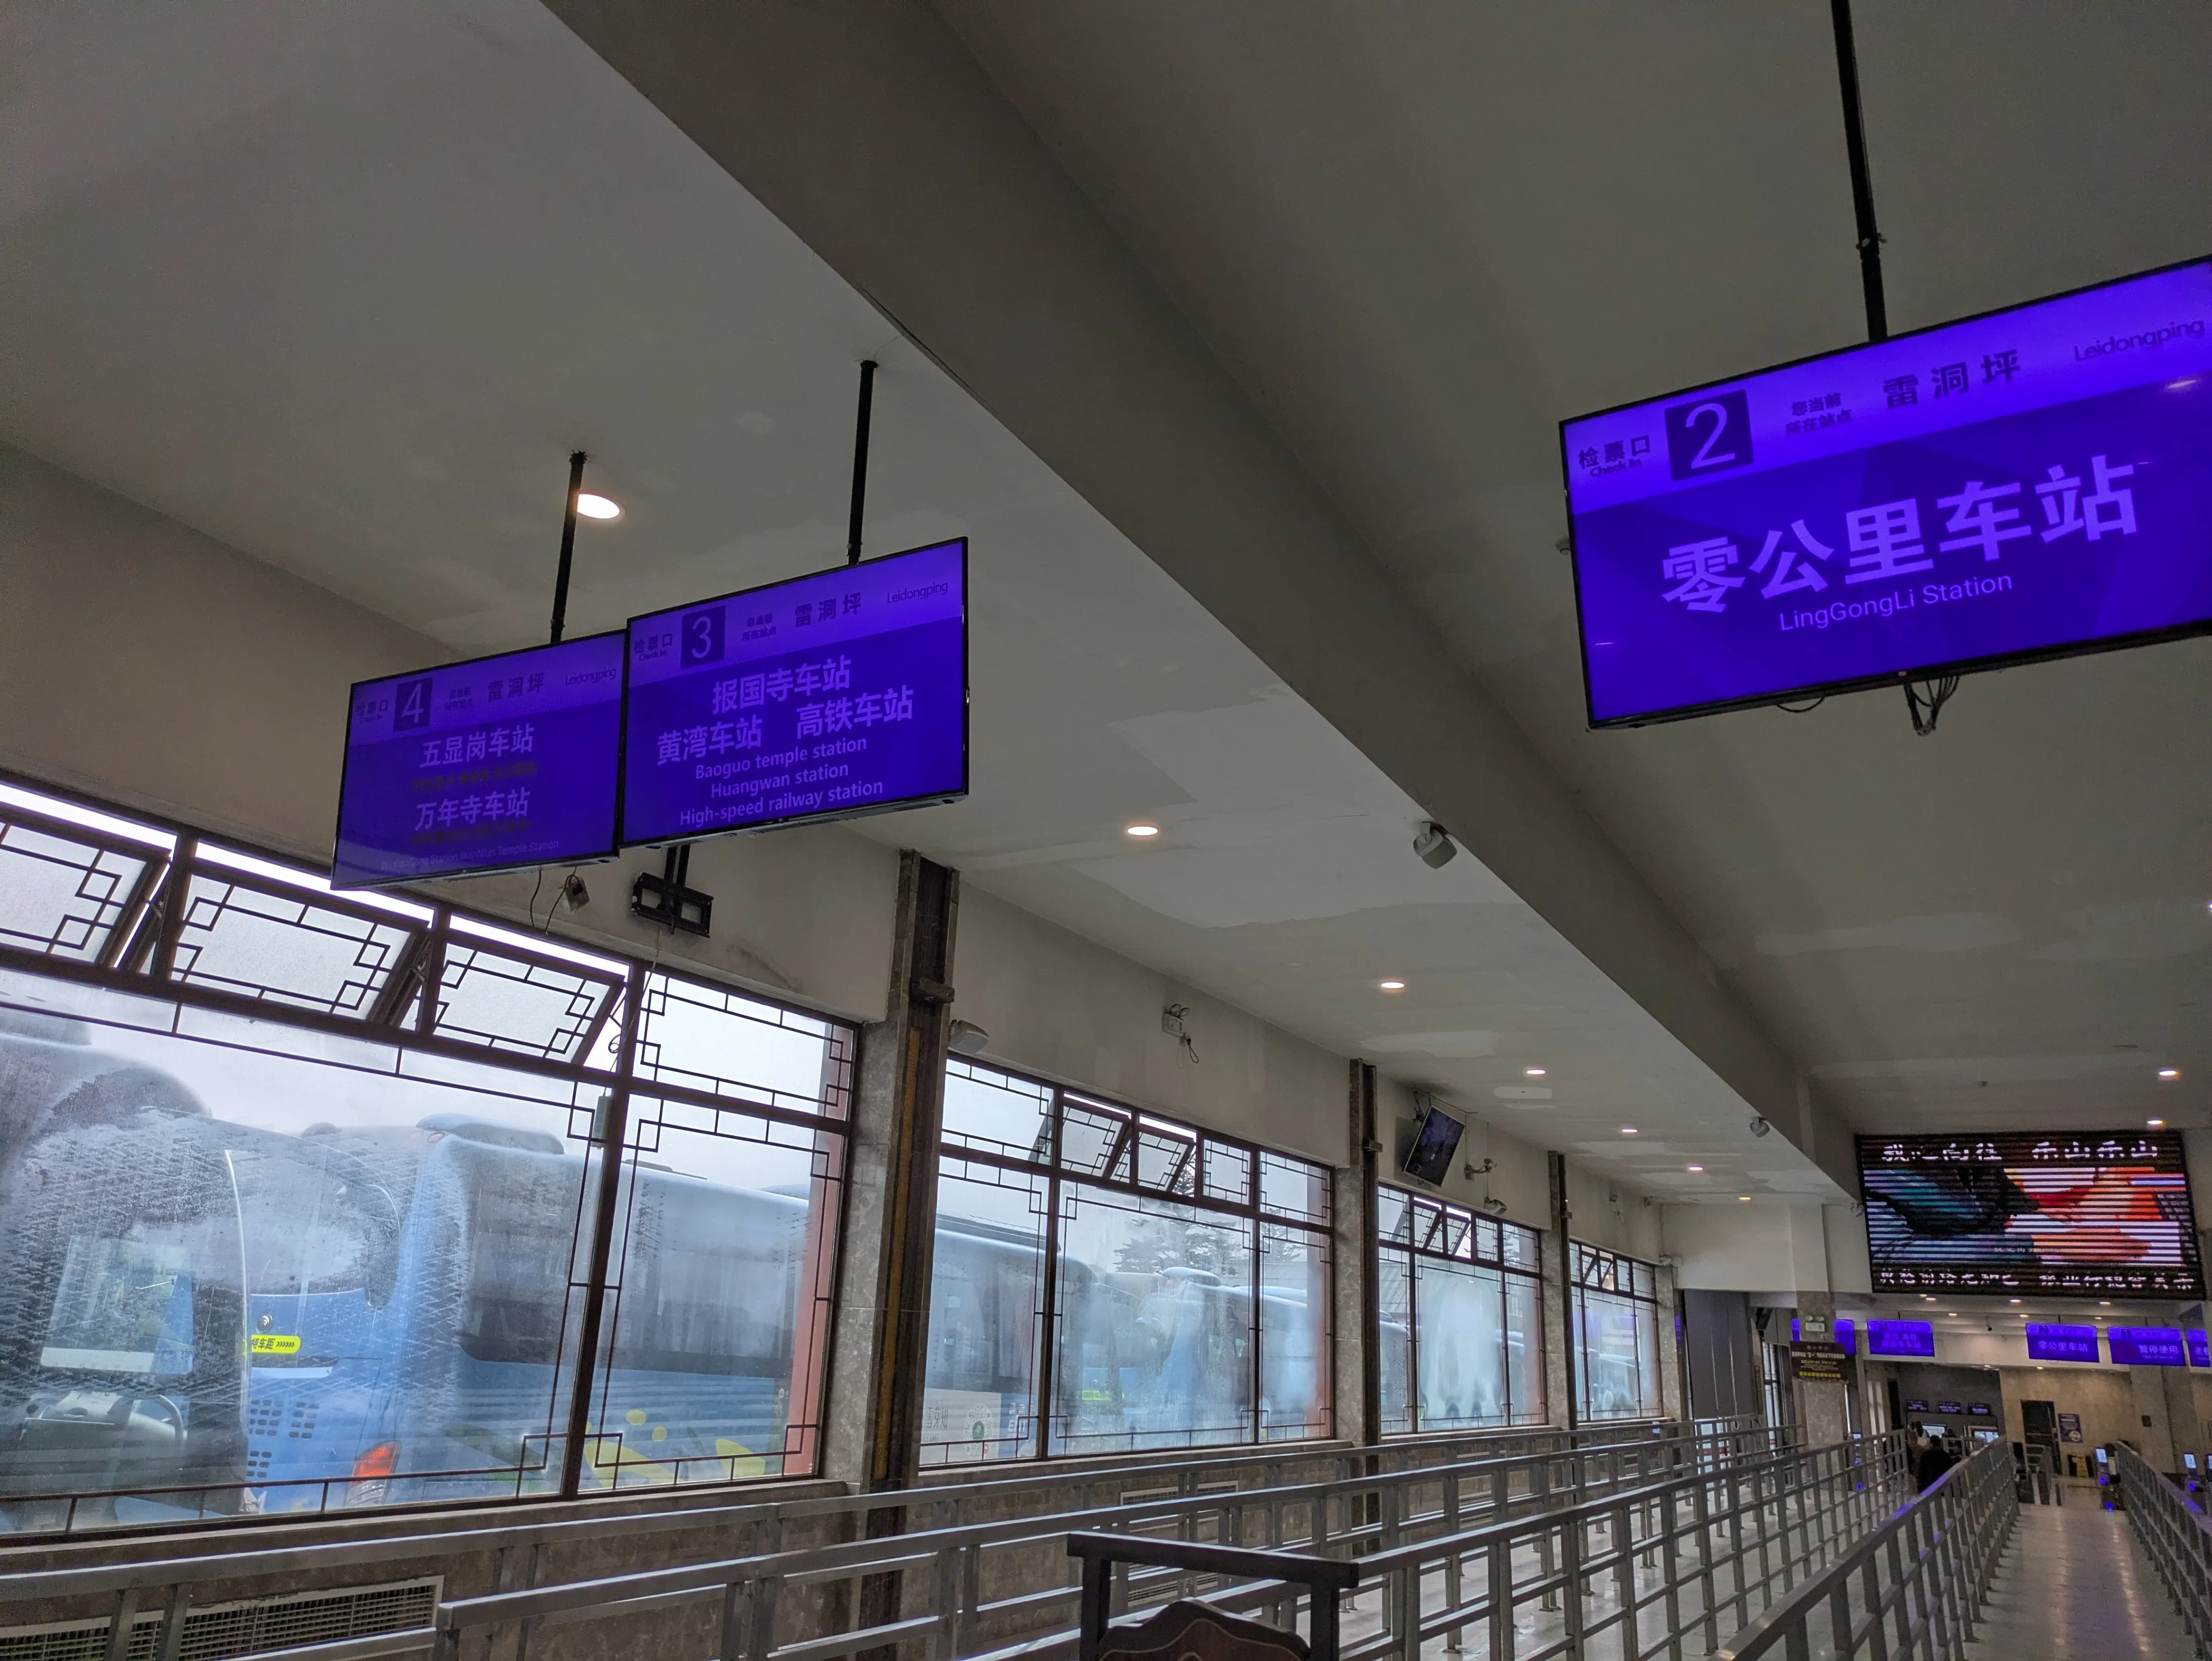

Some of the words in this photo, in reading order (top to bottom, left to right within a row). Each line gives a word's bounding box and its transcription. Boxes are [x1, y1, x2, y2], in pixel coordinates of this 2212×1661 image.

[2075, 320, 2204, 362] Leidongping
[1883, 349, 2021, 409] 雷洞坪
[1785, 408, 1853, 436] 所在站点
[1791, 392, 1842, 416] 您当前
[1578, 435, 1650, 470] 检票口
[1685, 403, 1736, 469] 2
[1589, 460, 1626, 477] Check
[1628, 458, 1642, 468] In
[1662, 454, 2138, 613] 零公里车站
[795, 591, 862, 628] 雷洞坪
[887, 582, 948, 603] Leidongping
[1779, 588, 1915, 630] LingGongLi
[1922, 574, 2012, 605] Station
[692, 616, 712, 658] 3
[488, 672, 544, 702] 雷洞坪
[566, 668, 616, 686] Leidongping
[712, 655, 851, 715] 报国寺车站
[401, 682, 424, 723] 4
[420, 723, 534, 768] 五显岗车站
[657, 715, 763, 766] 黄湾车站
[796, 685, 914, 739] 高铁车站
[696, 759, 750, 780] Baoguo
[756, 746, 807, 769] temple
[813, 738, 867, 756] station
[711, 774, 790, 799] Huangwan
[795, 763, 849, 784] station
[415, 787, 530, 830] 万年寺车站
[680, 797, 764, 827] High-speed
[769, 791, 823, 811] railway
[828, 780, 882, 802] station
[498, 844, 527, 856] Temple
[2038, 1341, 2089, 1352] 零公里车站
[2138, 1345, 2178, 1354] 暂停使用
